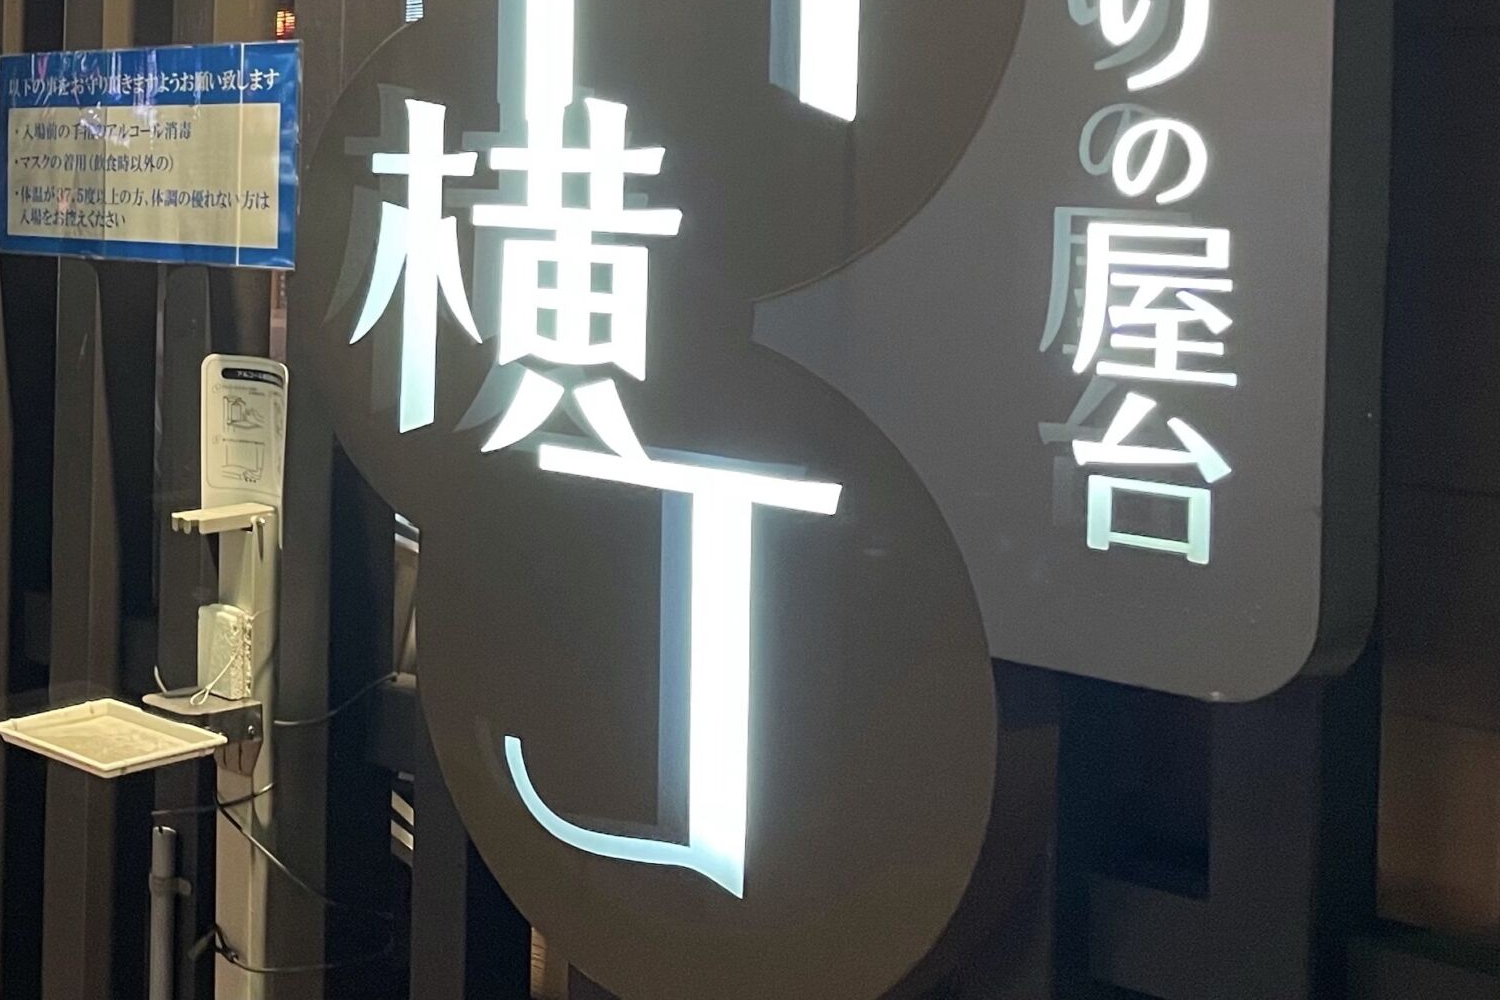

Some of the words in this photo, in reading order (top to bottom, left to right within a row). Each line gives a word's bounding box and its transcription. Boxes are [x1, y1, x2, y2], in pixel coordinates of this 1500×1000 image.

[20, 208, 127, 230] 入場をお控えください
